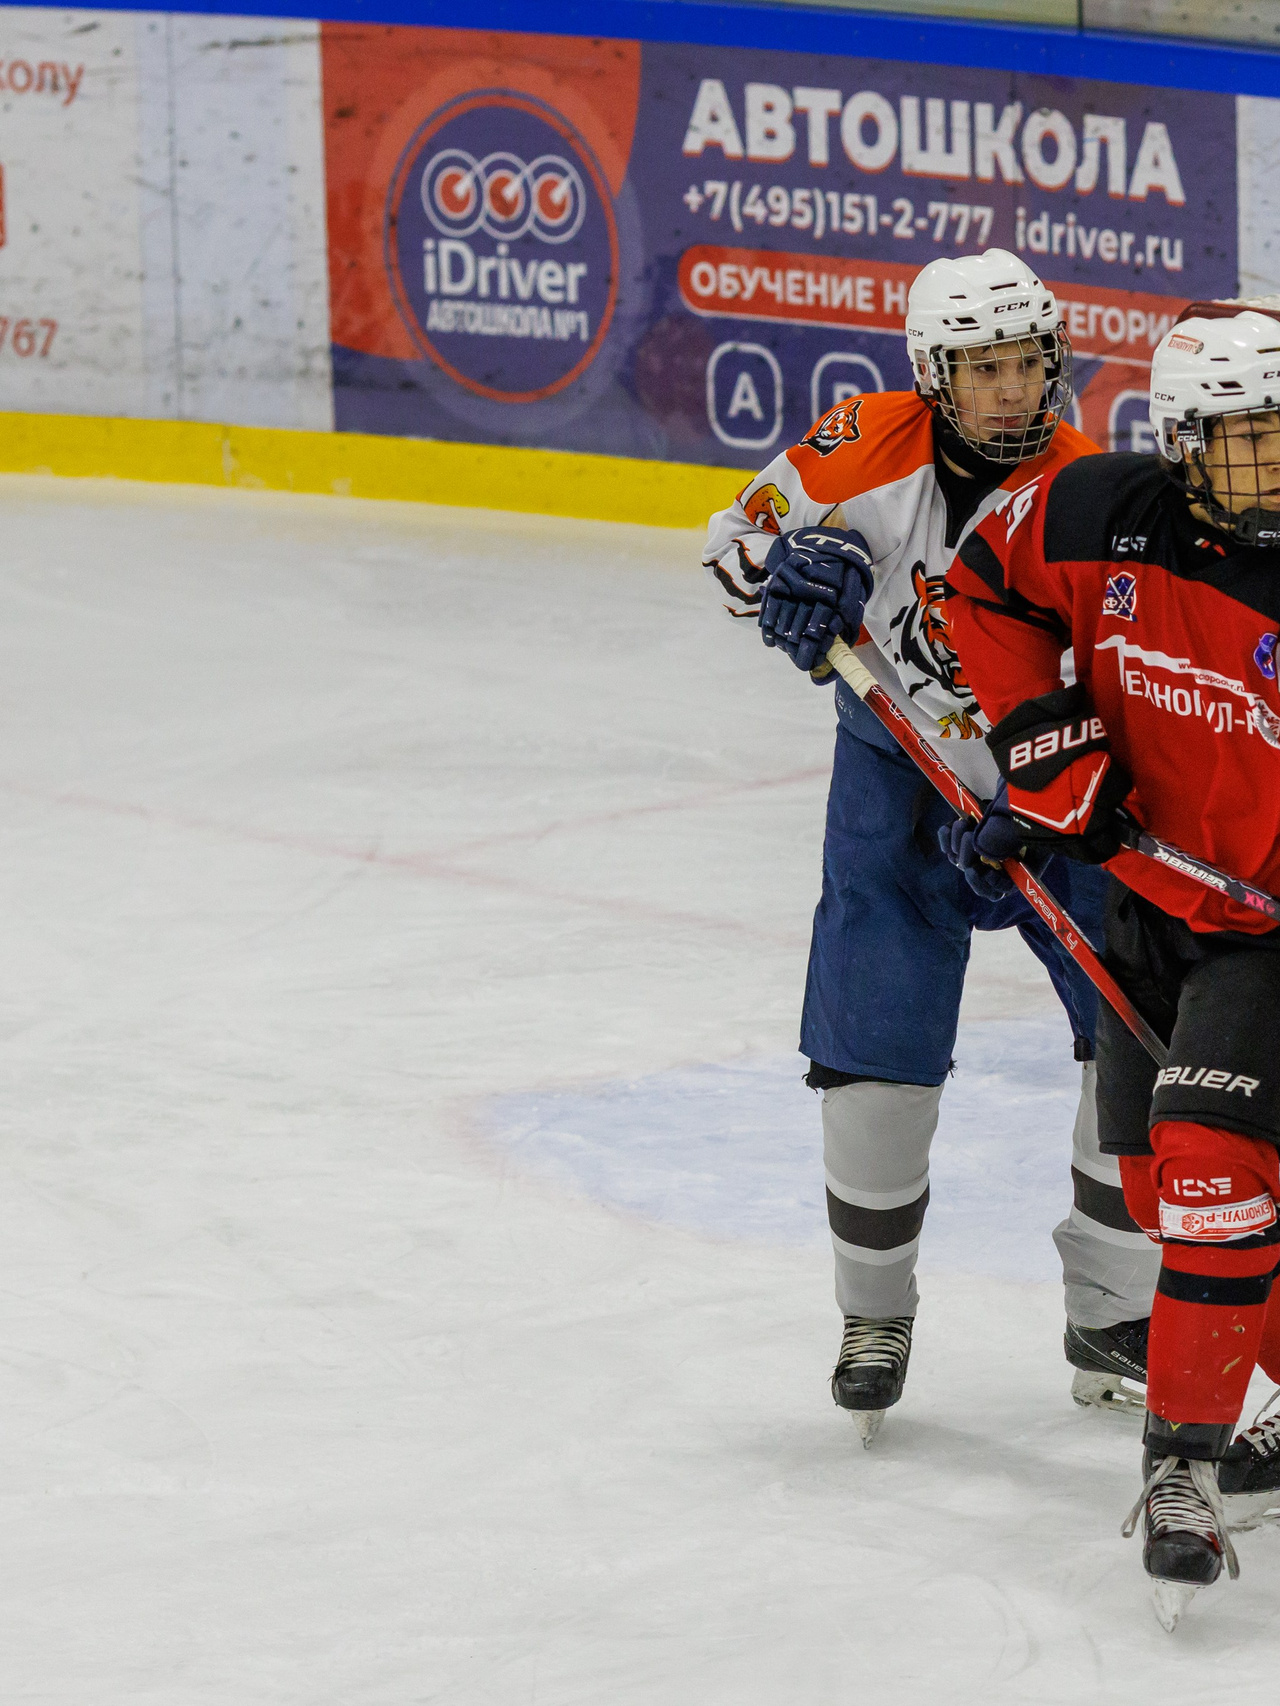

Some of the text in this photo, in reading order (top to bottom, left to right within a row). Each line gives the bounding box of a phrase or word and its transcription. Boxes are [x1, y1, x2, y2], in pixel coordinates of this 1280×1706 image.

[0, 58, 85, 108] олу
[682, 78, 1187, 206] АВТОШКОЛА
[683, 179, 1184, 272] +7(495)151-2-777 idriver.ru
[422, 236, 588, 305] iDriver
[689, 260, 877, 314] ОБУЧЕНИЕ
[1057, 299, 1180, 348] ТЕГОРИ
[993, 300, 1030, 314] CCM
[908, 328, 924, 338] CCM
[1154, 392, 1176, 403] CCM
[1104, 595, 1134, 610] ФХ
[1009, 717, 1108, 772] BAUE
[1164, 851, 1229, 893] BAUER
[1025, 878, 1058, 932] VAPOR
